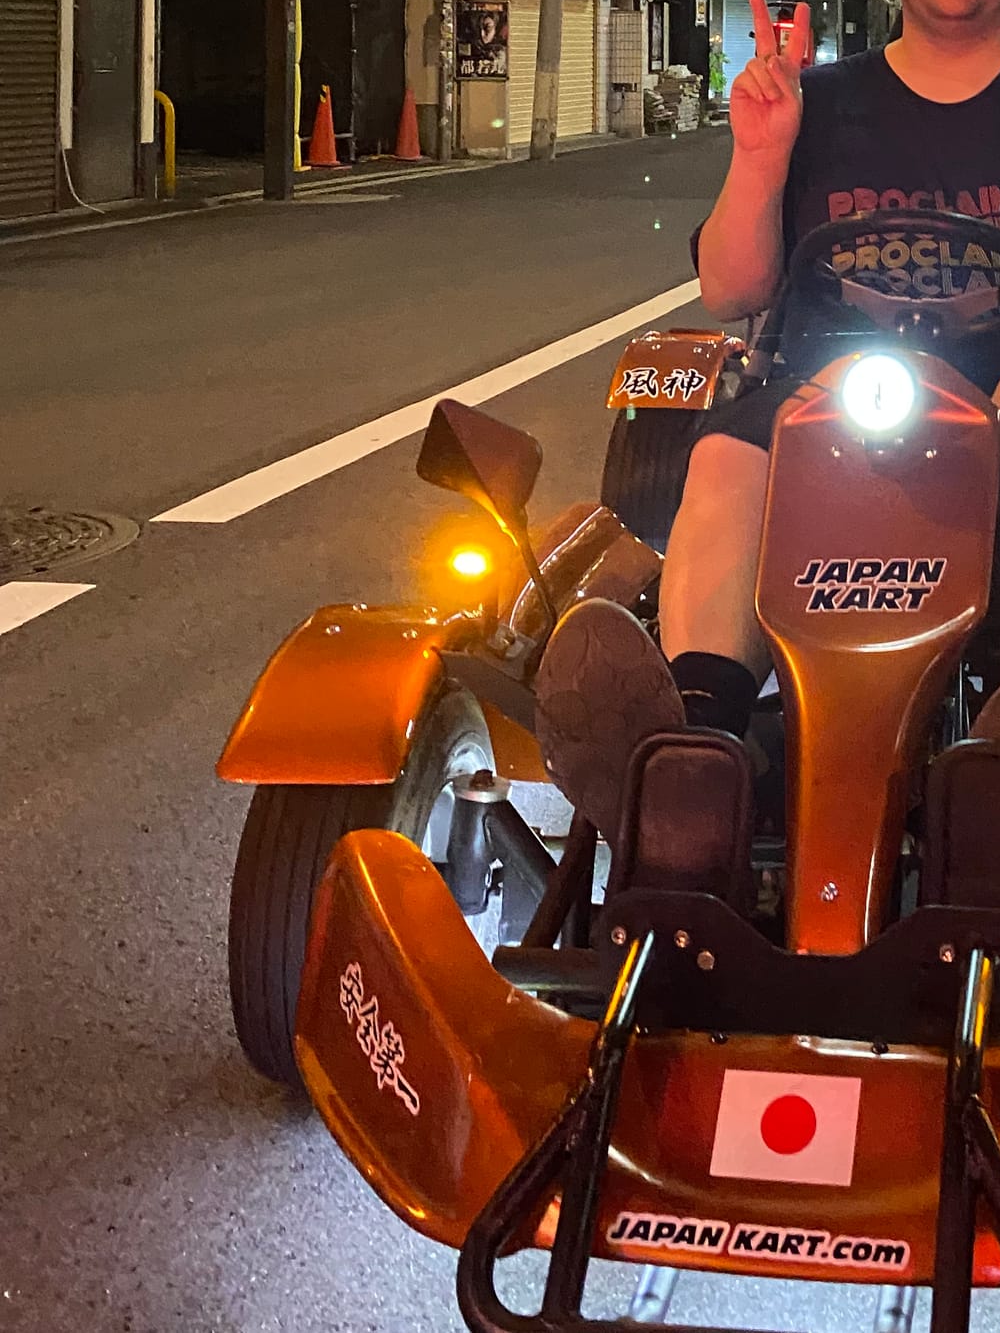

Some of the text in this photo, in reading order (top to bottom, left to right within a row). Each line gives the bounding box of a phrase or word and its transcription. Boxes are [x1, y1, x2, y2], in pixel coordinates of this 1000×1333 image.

[615, 367, 706, 402] 風神
[795, 558, 947, 586] JAPAN
[806, 586, 933, 612] KART
[340, 962, 419, 1115] 安全第一
[609, 1217, 907, 1266] JAPAN KART.com
